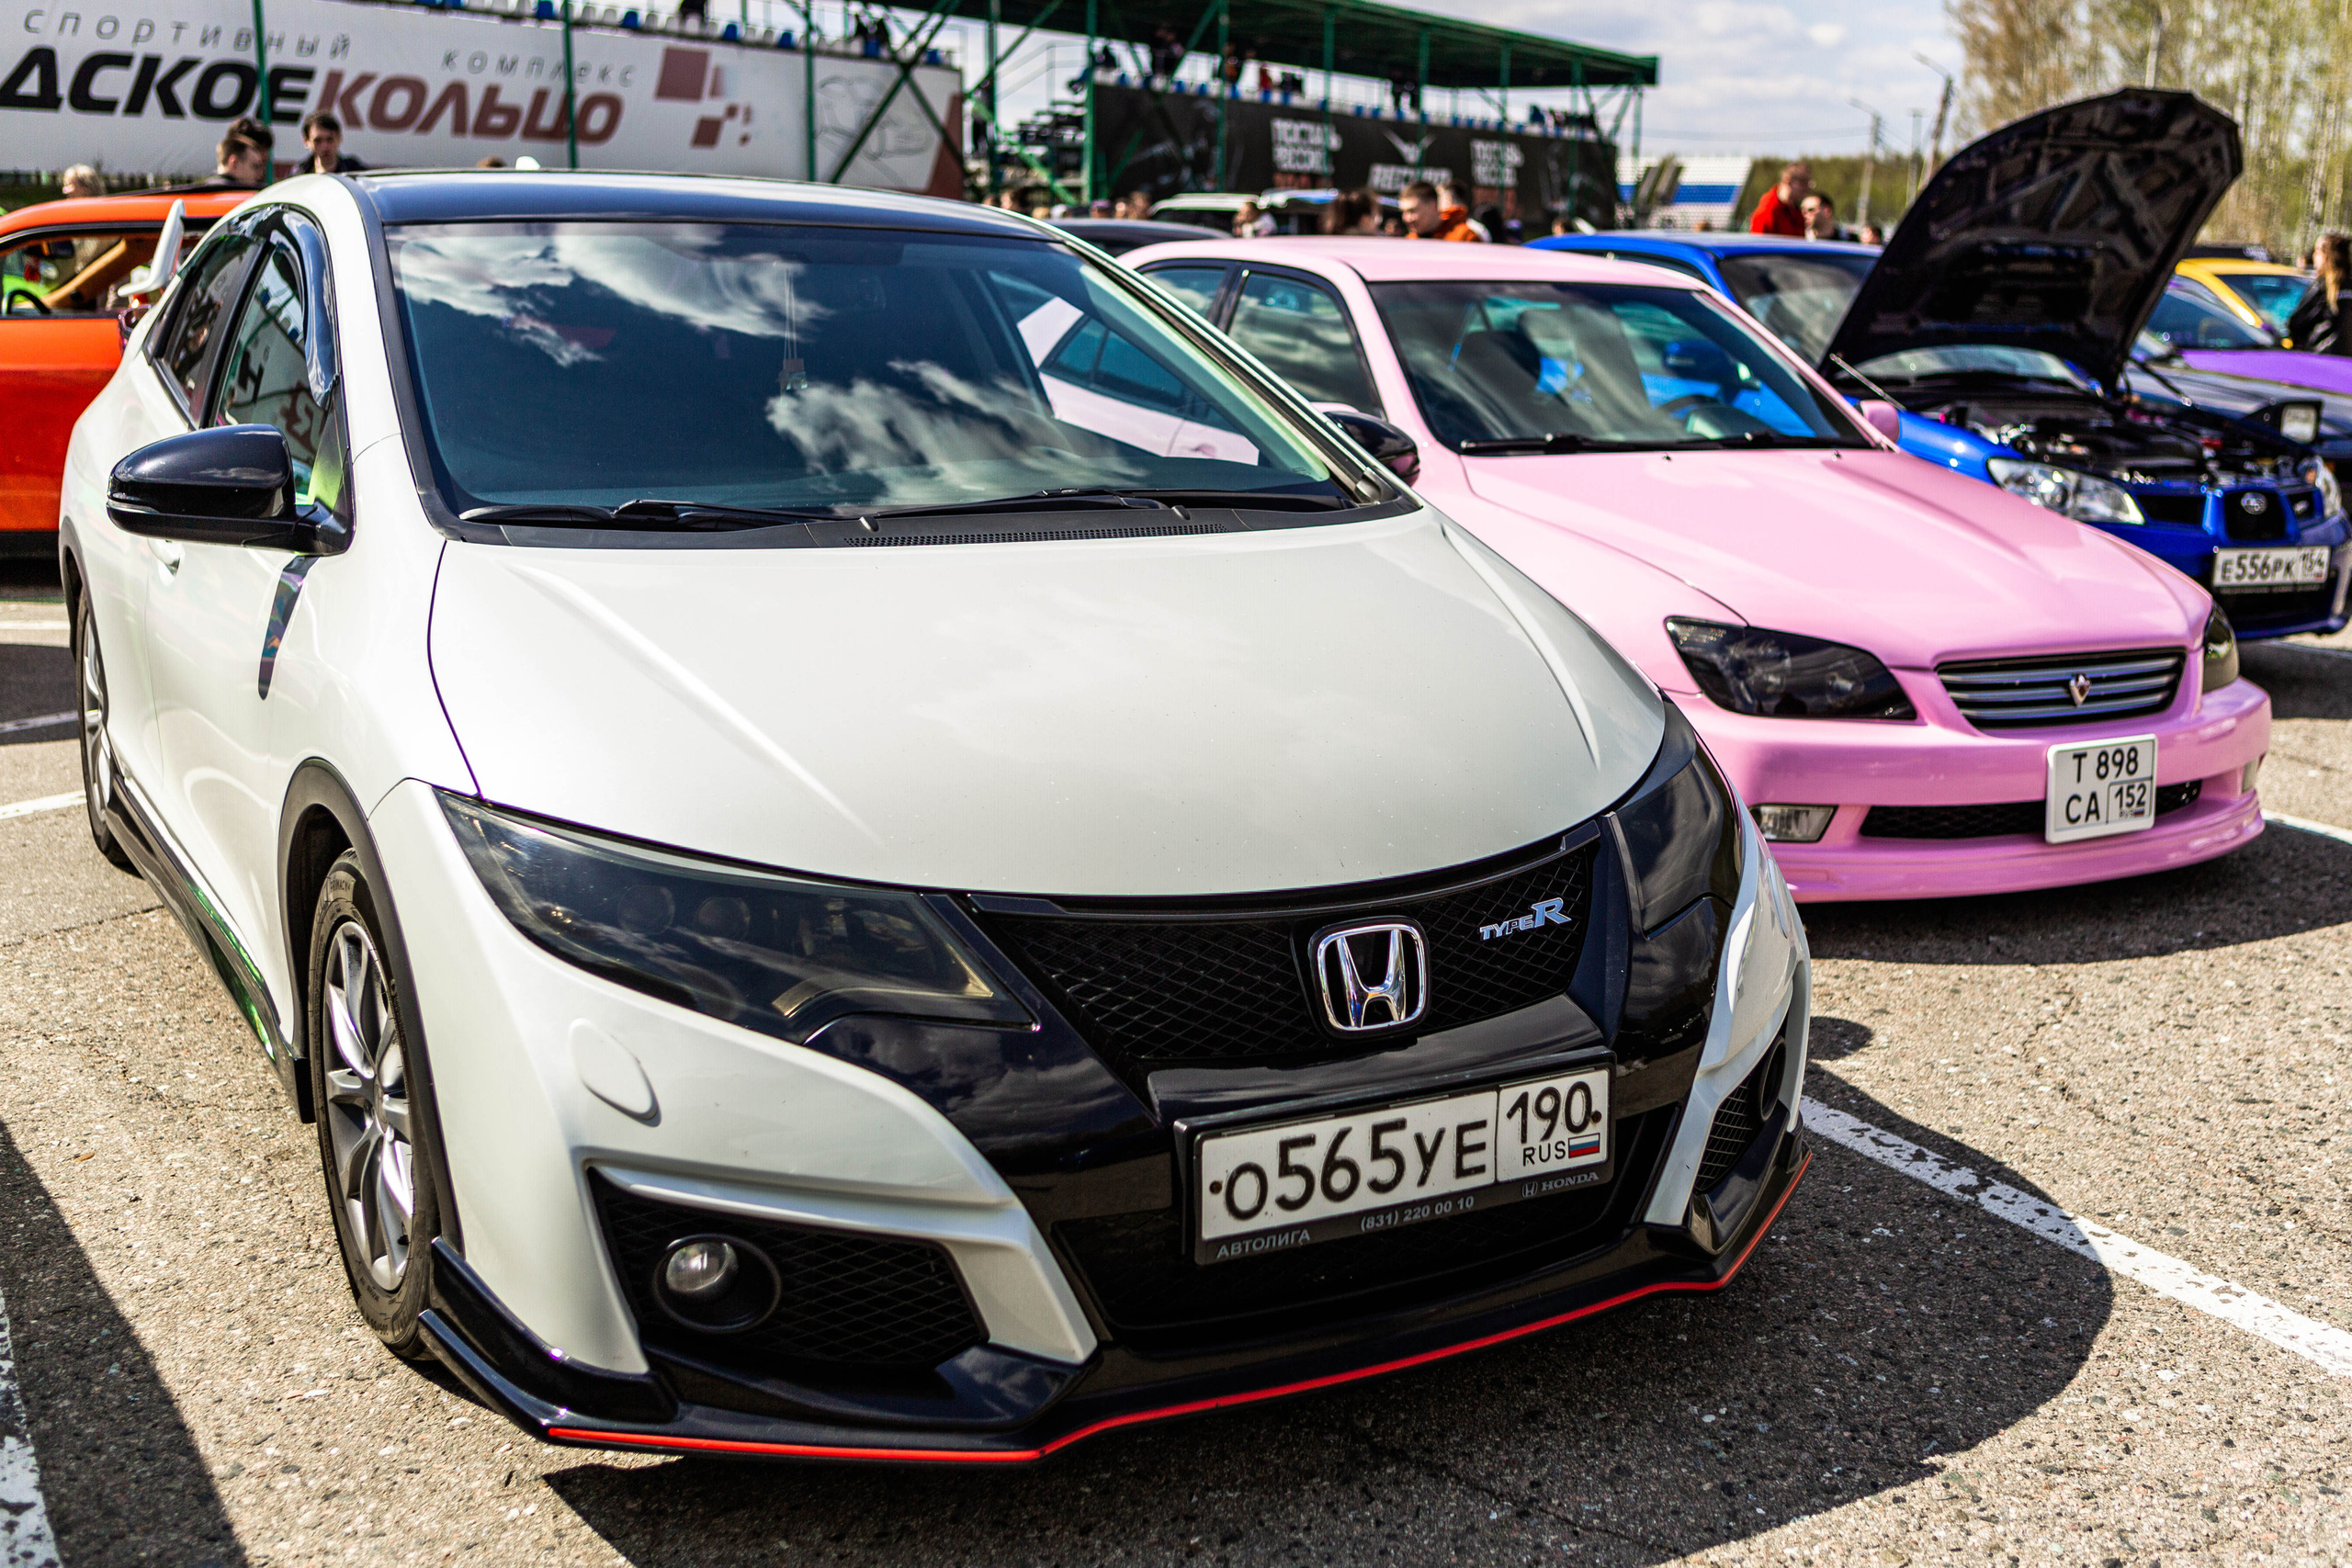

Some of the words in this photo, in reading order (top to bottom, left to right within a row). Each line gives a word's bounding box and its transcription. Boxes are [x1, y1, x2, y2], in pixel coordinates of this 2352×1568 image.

[2096, 746, 2139, 781] 898
[2114, 783, 2146, 809] 152
[1506, 1080, 1594, 1145] 190
[1521, 1140, 1567, 1168] RUS
[1541, 1171, 1600, 1191] HONDA
[1361, 1210, 1398, 1232] (831)
[1403, 1204, 1430, 1223] 220
[1435, 1200, 1453, 1214] 00
[1457, 1195, 1475, 1212] 10
[1216, 1227, 1311, 1259] АВТОЛИГА
